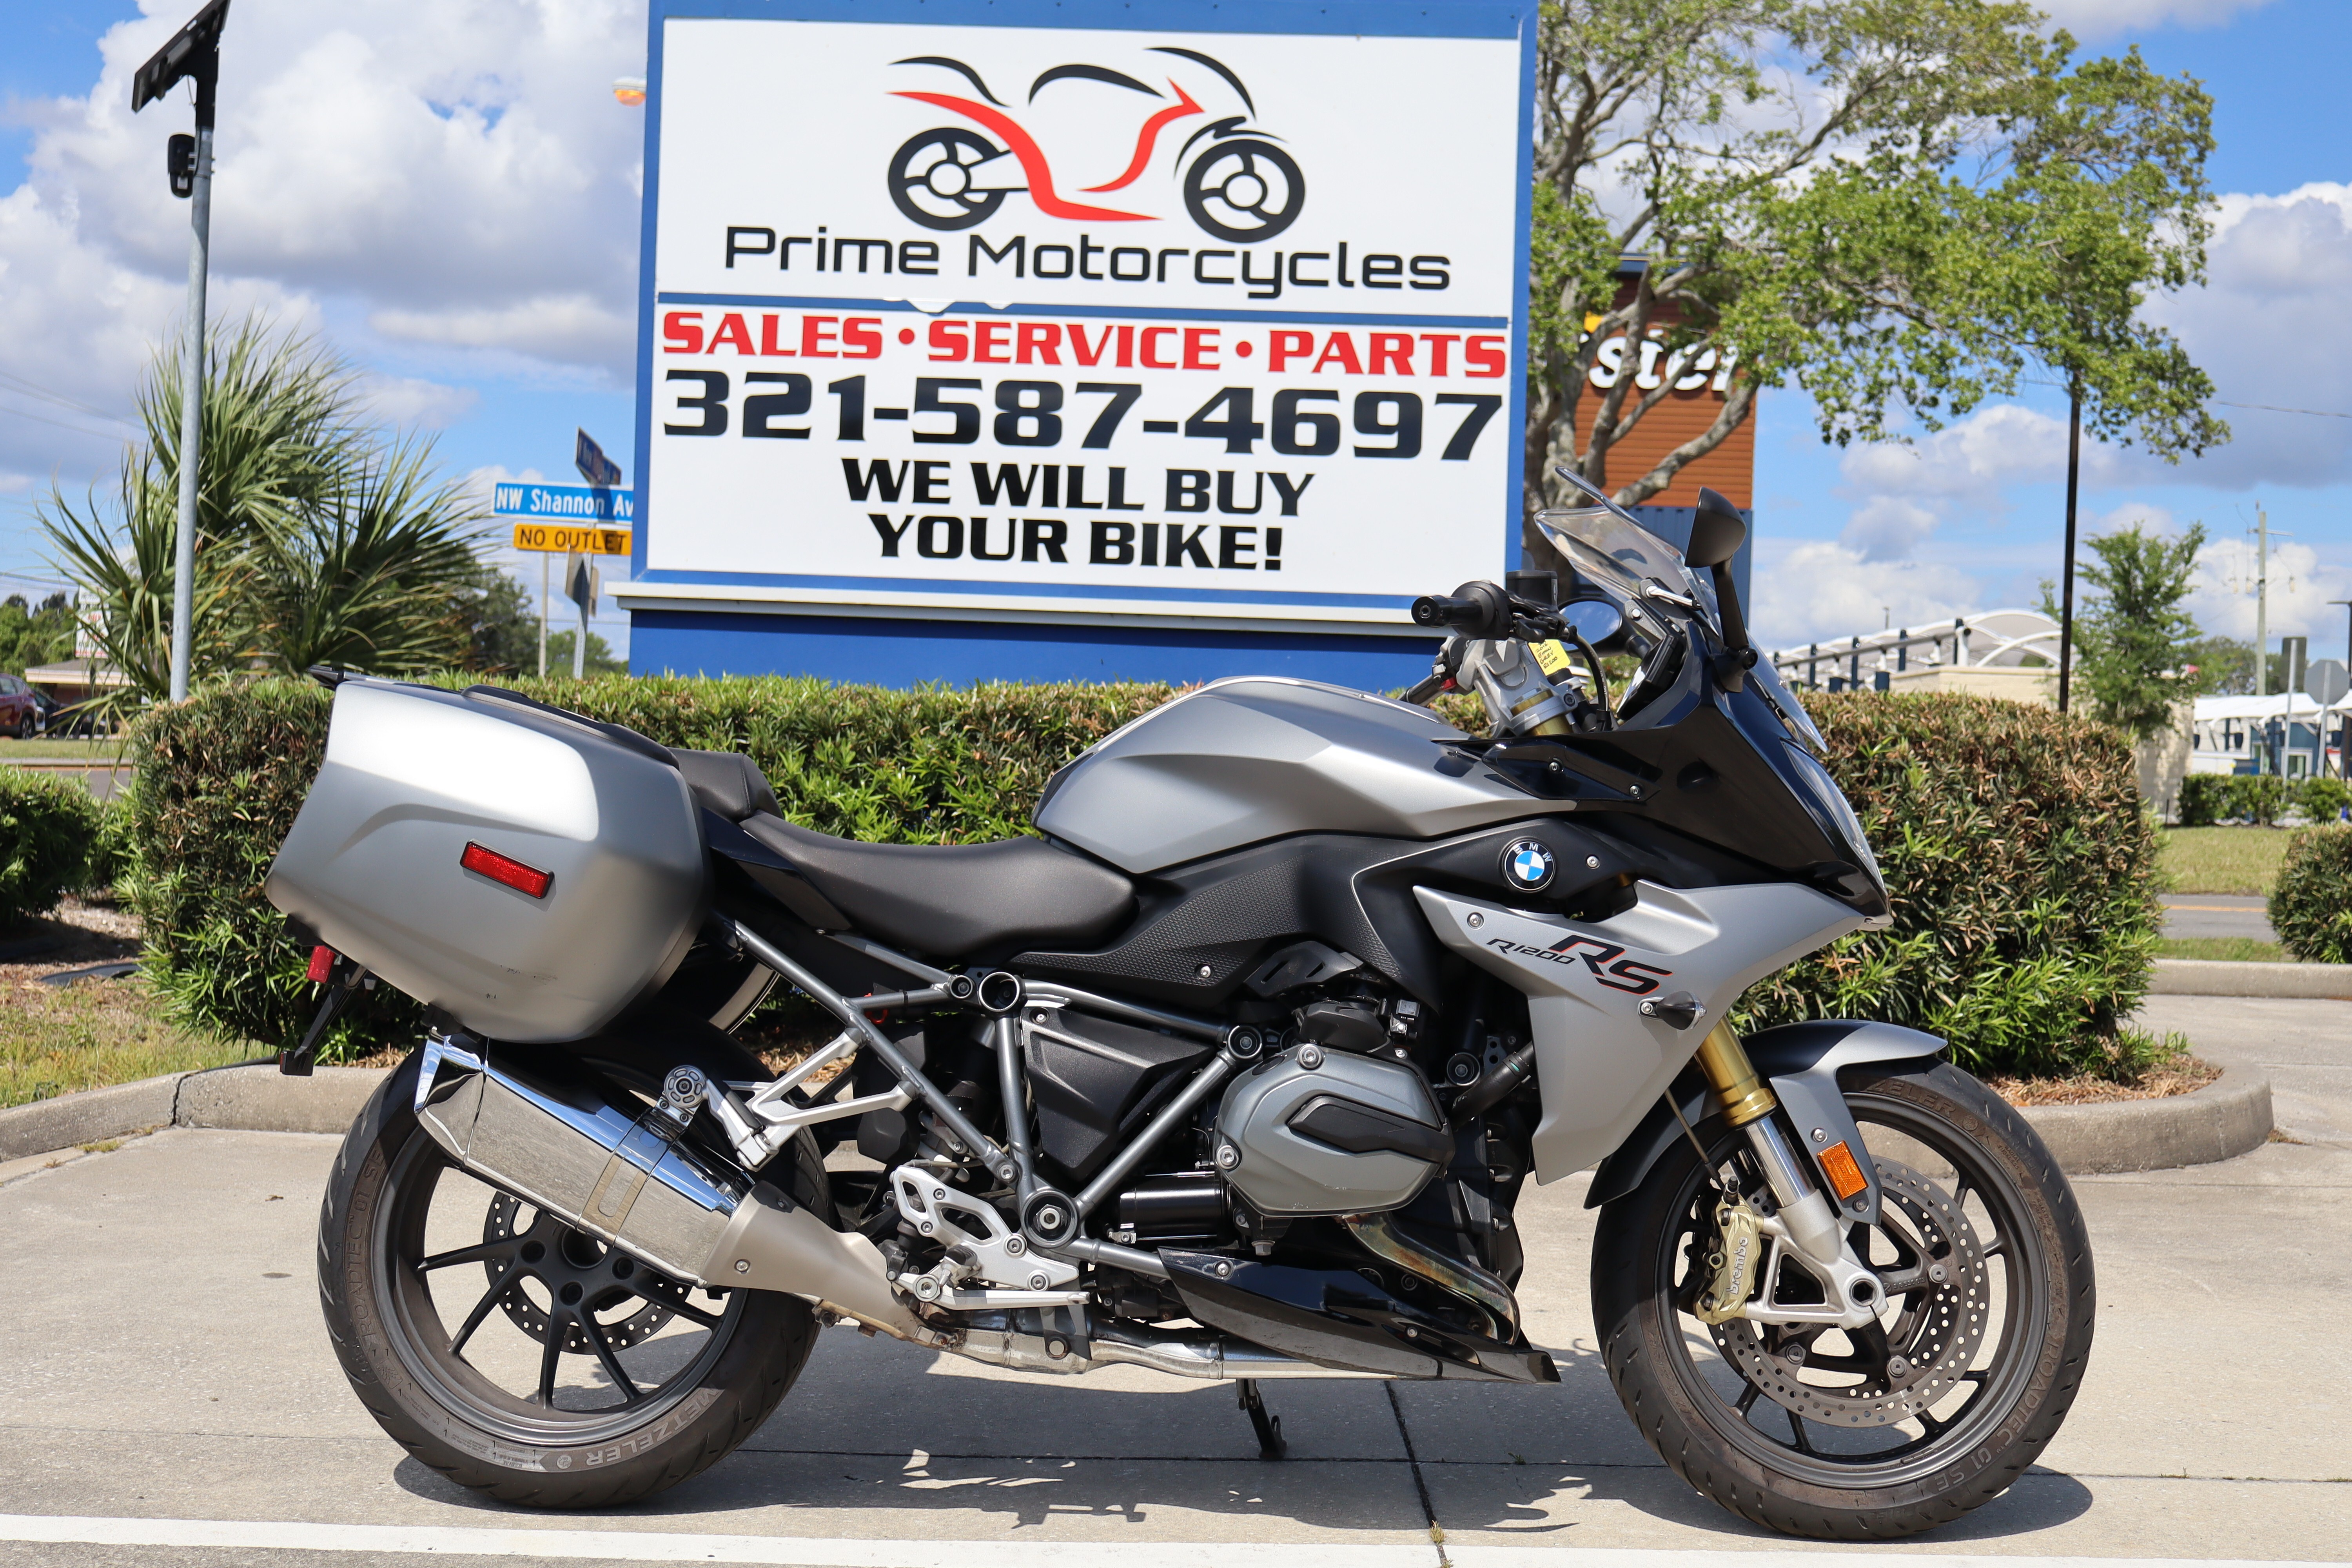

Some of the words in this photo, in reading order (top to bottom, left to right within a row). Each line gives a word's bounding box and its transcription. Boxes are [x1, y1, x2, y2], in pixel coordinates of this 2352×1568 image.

[725, 226, 939, 275] Prime
[968, 234, 1451, 299] Motorcycles
[663, 312, 882, 359] SALES
[928, 320, 1220, 371] SERVICE
[1267, 330, 1506, 379] PARTS
[663, 369, 1503, 461] 321-587-4697
[496, 486, 524, 510] NW
[530, 488, 605, 515] Shannon
[841, 458, 952, 505] WE
[969, 461, 1145, 511] WILL
[1164, 468, 1316, 517] BUY
[520, 528, 546, 546] NO
[555, 531, 627, 551] OUTLET
[867, 513, 1069, 564] YOUR
[1089, 521, 1283, 571] BIKE!
[1513, 842, 1552, 862] BMW
[1486, 938, 1575, 965] R1200
[1548, 935, 1674, 996] RS
[1726, 1236, 1748, 1294] brembo
[586, 1384, 720, 1466] METZELER
[1935, 1465, 1965, 1491] SE
[1971, 1447, 1992, 1470] 01
